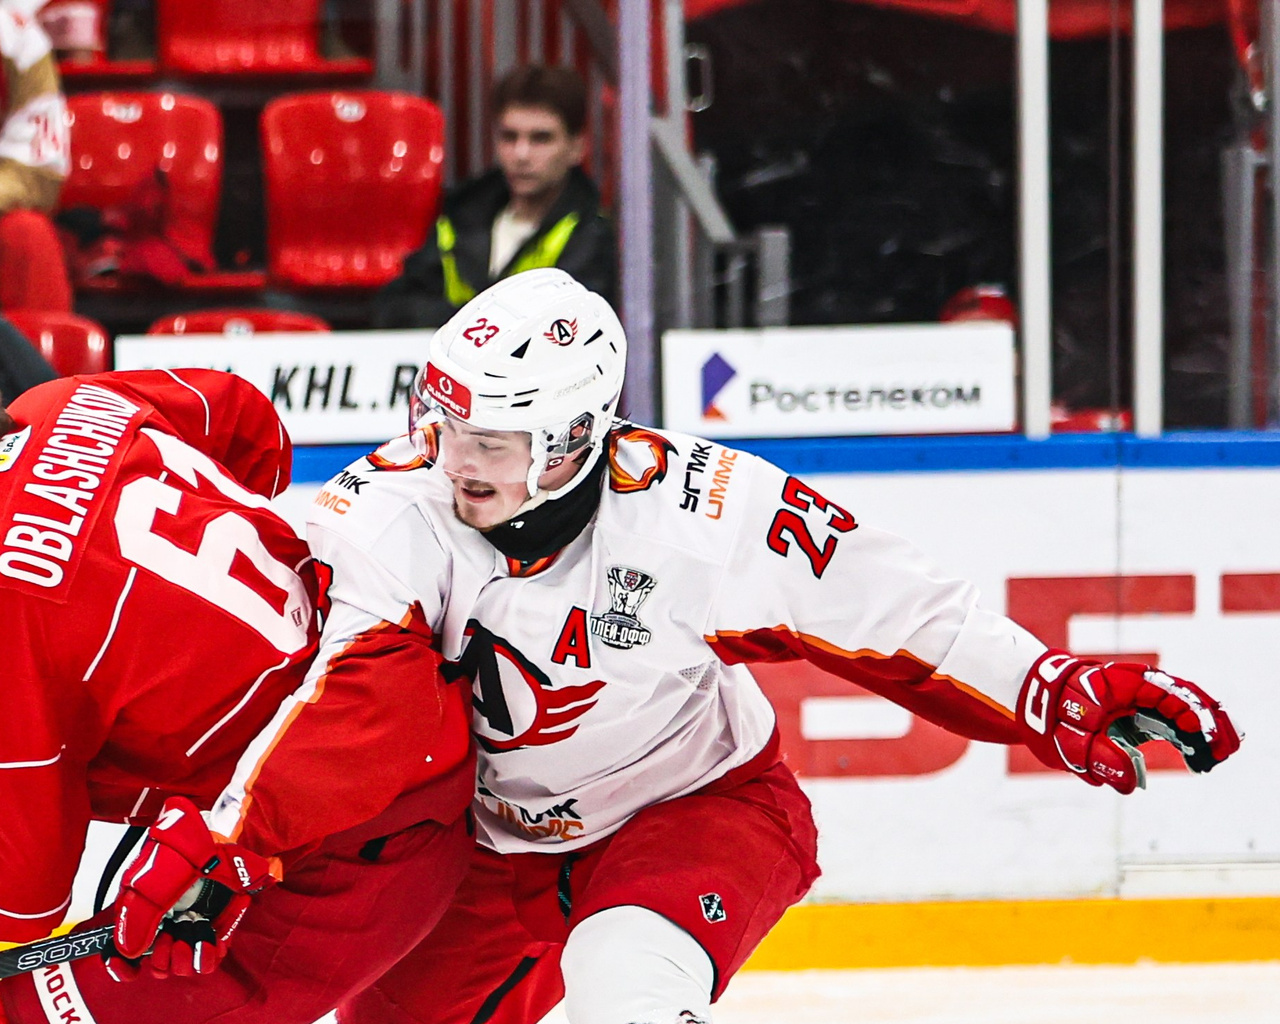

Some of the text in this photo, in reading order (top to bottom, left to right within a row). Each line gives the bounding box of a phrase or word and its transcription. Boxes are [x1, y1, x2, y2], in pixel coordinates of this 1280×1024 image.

[463, 317, 500, 348] 23
[749, 381, 982, 413] Ростелеком
[679, 442, 713, 513] УГМК
[704, 448, 738, 520] UMMC
[114, 427, 313, 656] 61
[766, 475, 859, 580] 23
[233, 856, 252, 888] CCM
